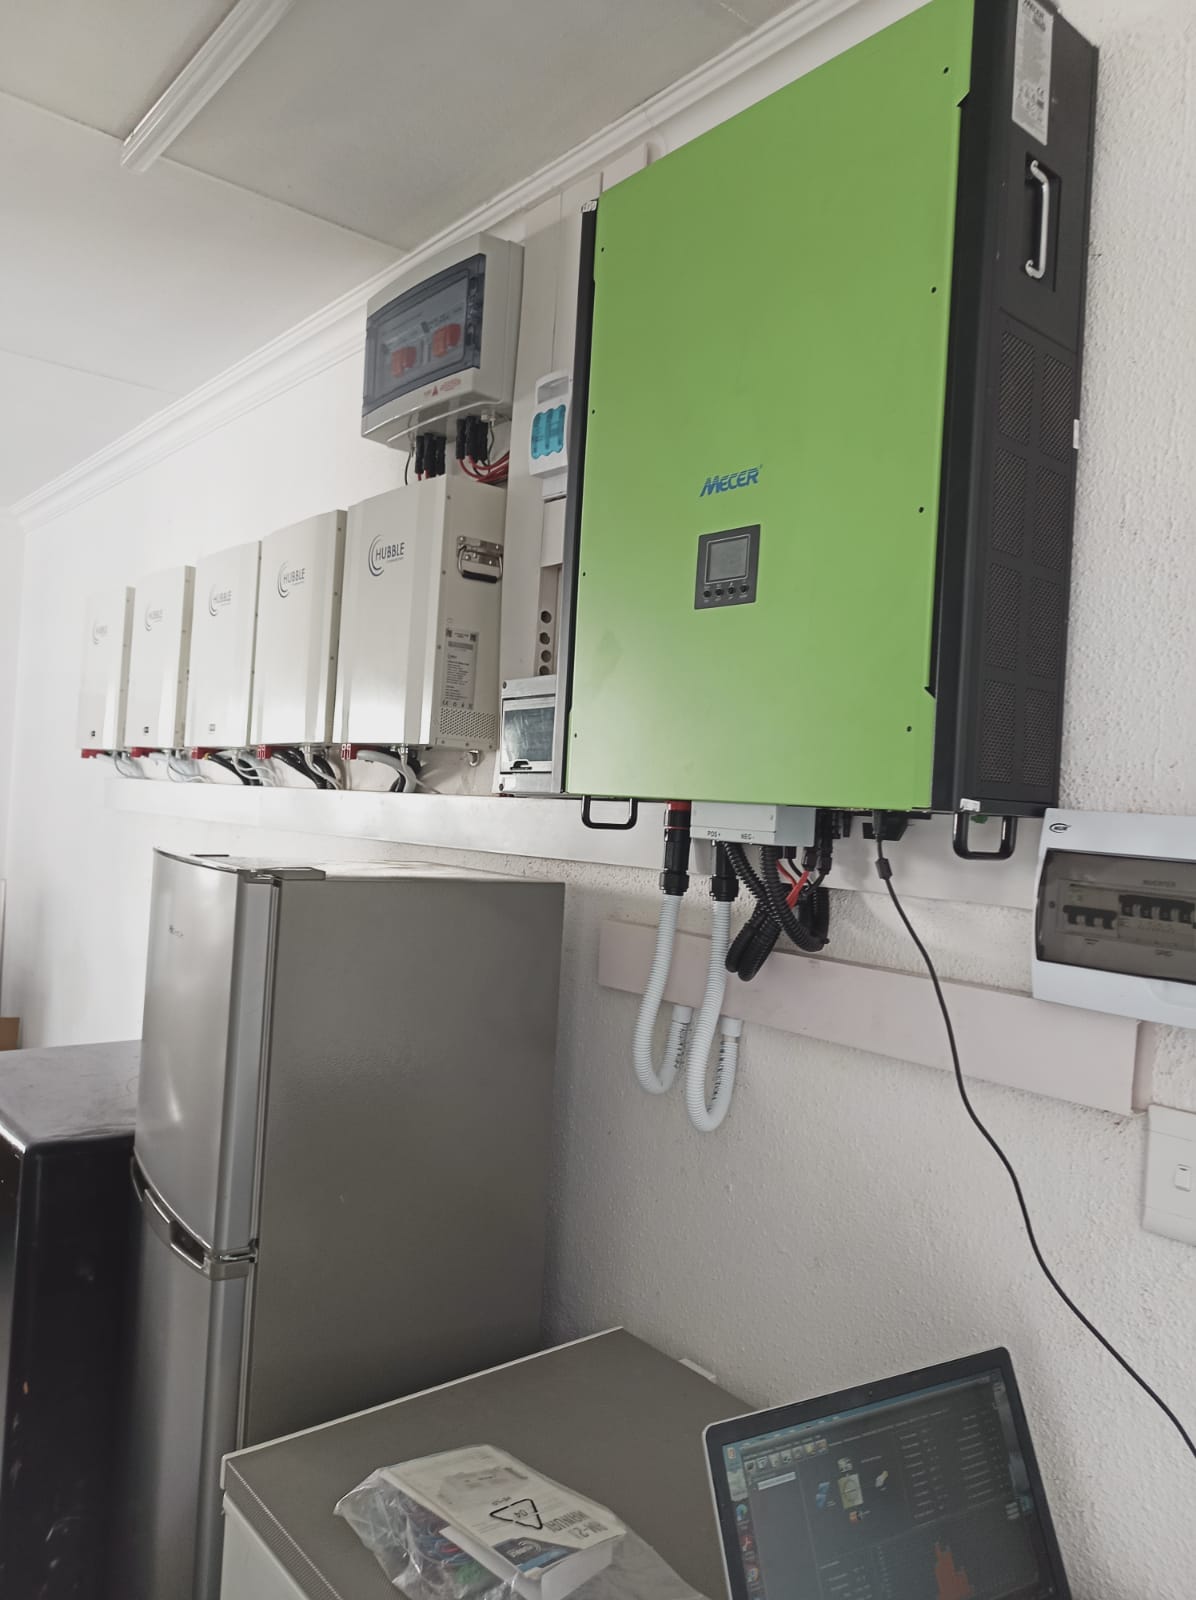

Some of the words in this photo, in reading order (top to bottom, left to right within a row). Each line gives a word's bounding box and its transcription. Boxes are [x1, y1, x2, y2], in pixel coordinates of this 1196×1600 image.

[700, 467, 760, 497] MECER
[375, 541, 405, 561] HUBBLE
[283, 567, 305, 584] HUBBLE
